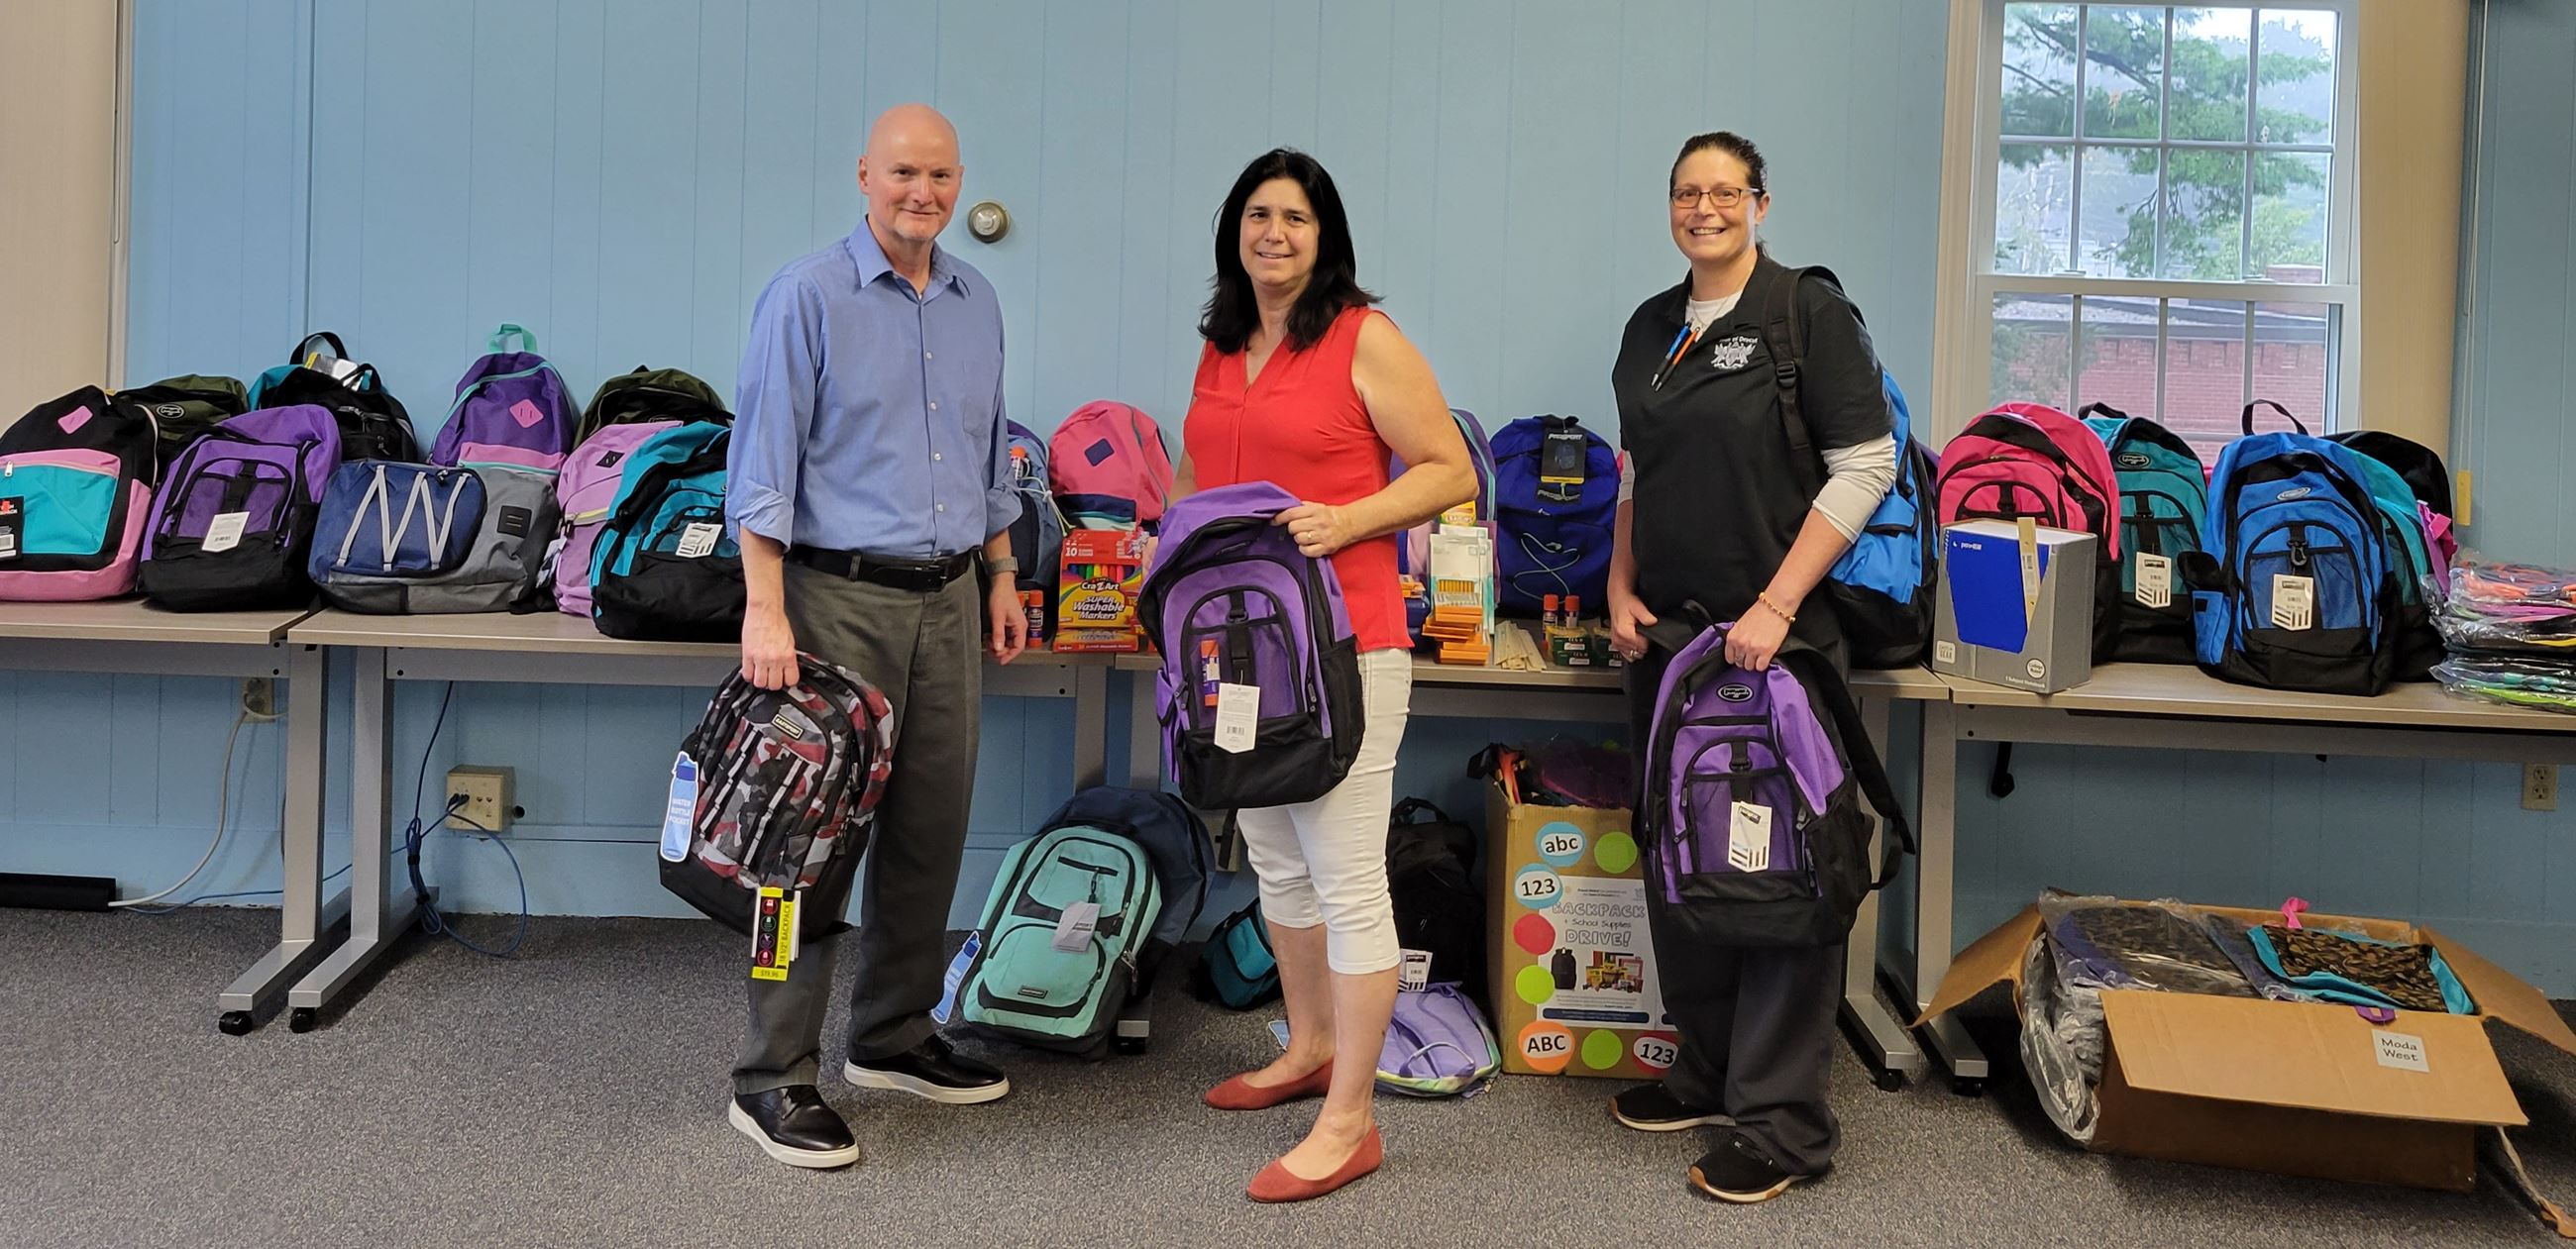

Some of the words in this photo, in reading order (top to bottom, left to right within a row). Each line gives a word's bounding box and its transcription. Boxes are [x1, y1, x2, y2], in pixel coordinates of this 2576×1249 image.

[1065, 547, 1078, 557] 10
[1073, 600, 1125, 612] Washable
[1079, 611, 1117, 620] Markers
[1545, 836, 1578, 853] abc
[1521, 878, 1556, 896] 123
[1553, 902, 1646, 918] BACKPACK
[782, 903, 791, 940] BACKPACK
[1601, 920, 1632, 930] Supplies
[1565, 929, 1632, 948] DRIVE!
[1527, 1035, 1566, 1054] ABC
[2381, 1038, 2417, 1051] Moda
[1640, 1043, 1674, 1065] 123
[2383, 1048, 2417, 1062] West
